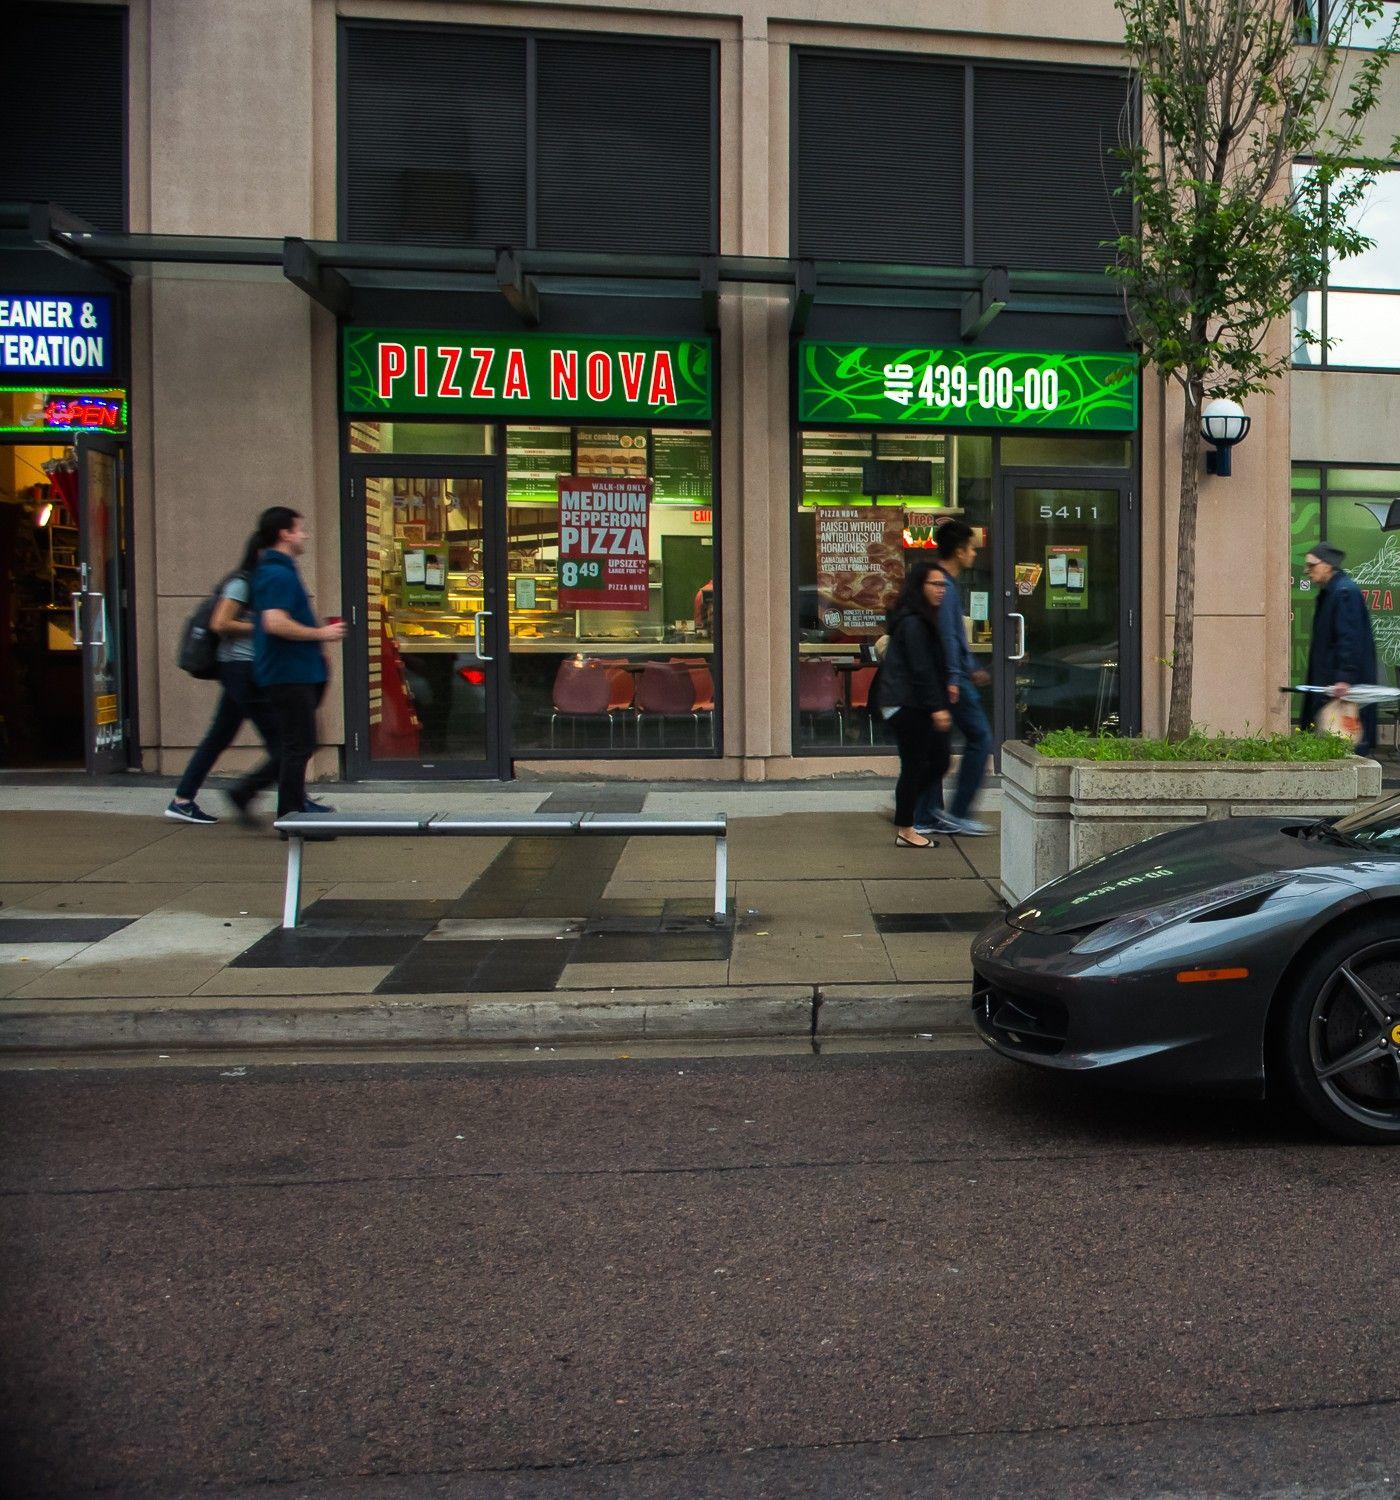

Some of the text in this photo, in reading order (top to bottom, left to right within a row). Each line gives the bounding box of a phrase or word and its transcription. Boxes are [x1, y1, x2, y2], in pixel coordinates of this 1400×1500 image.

[80, 302, 97, 328] &
[378, 342, 678, 405] PIZZA NOVA
[883, 363, 1058, 411] 416 439-00-00
[45, 402, 118, 426] OPEN
[592, 483, 625, 491] WALK-IN
[561, 491, 647, 512] MEDIUM
[561, 511, 647, 528] PEPPERONI
[841, 510, 858, 518] NOVA
[908, 511, 934, 527] free
[1040, 506, 1097, 519] 5411
[820, 521, 886, 532] RAISED WITHOUT
[561, 527, 645, 555] PIZZA
[820, 532, 882, 543] ANTIBIOTICS OR
[608, 559, 638, 568] UPSIZE
[629, 584, 646, 592] NOVA
